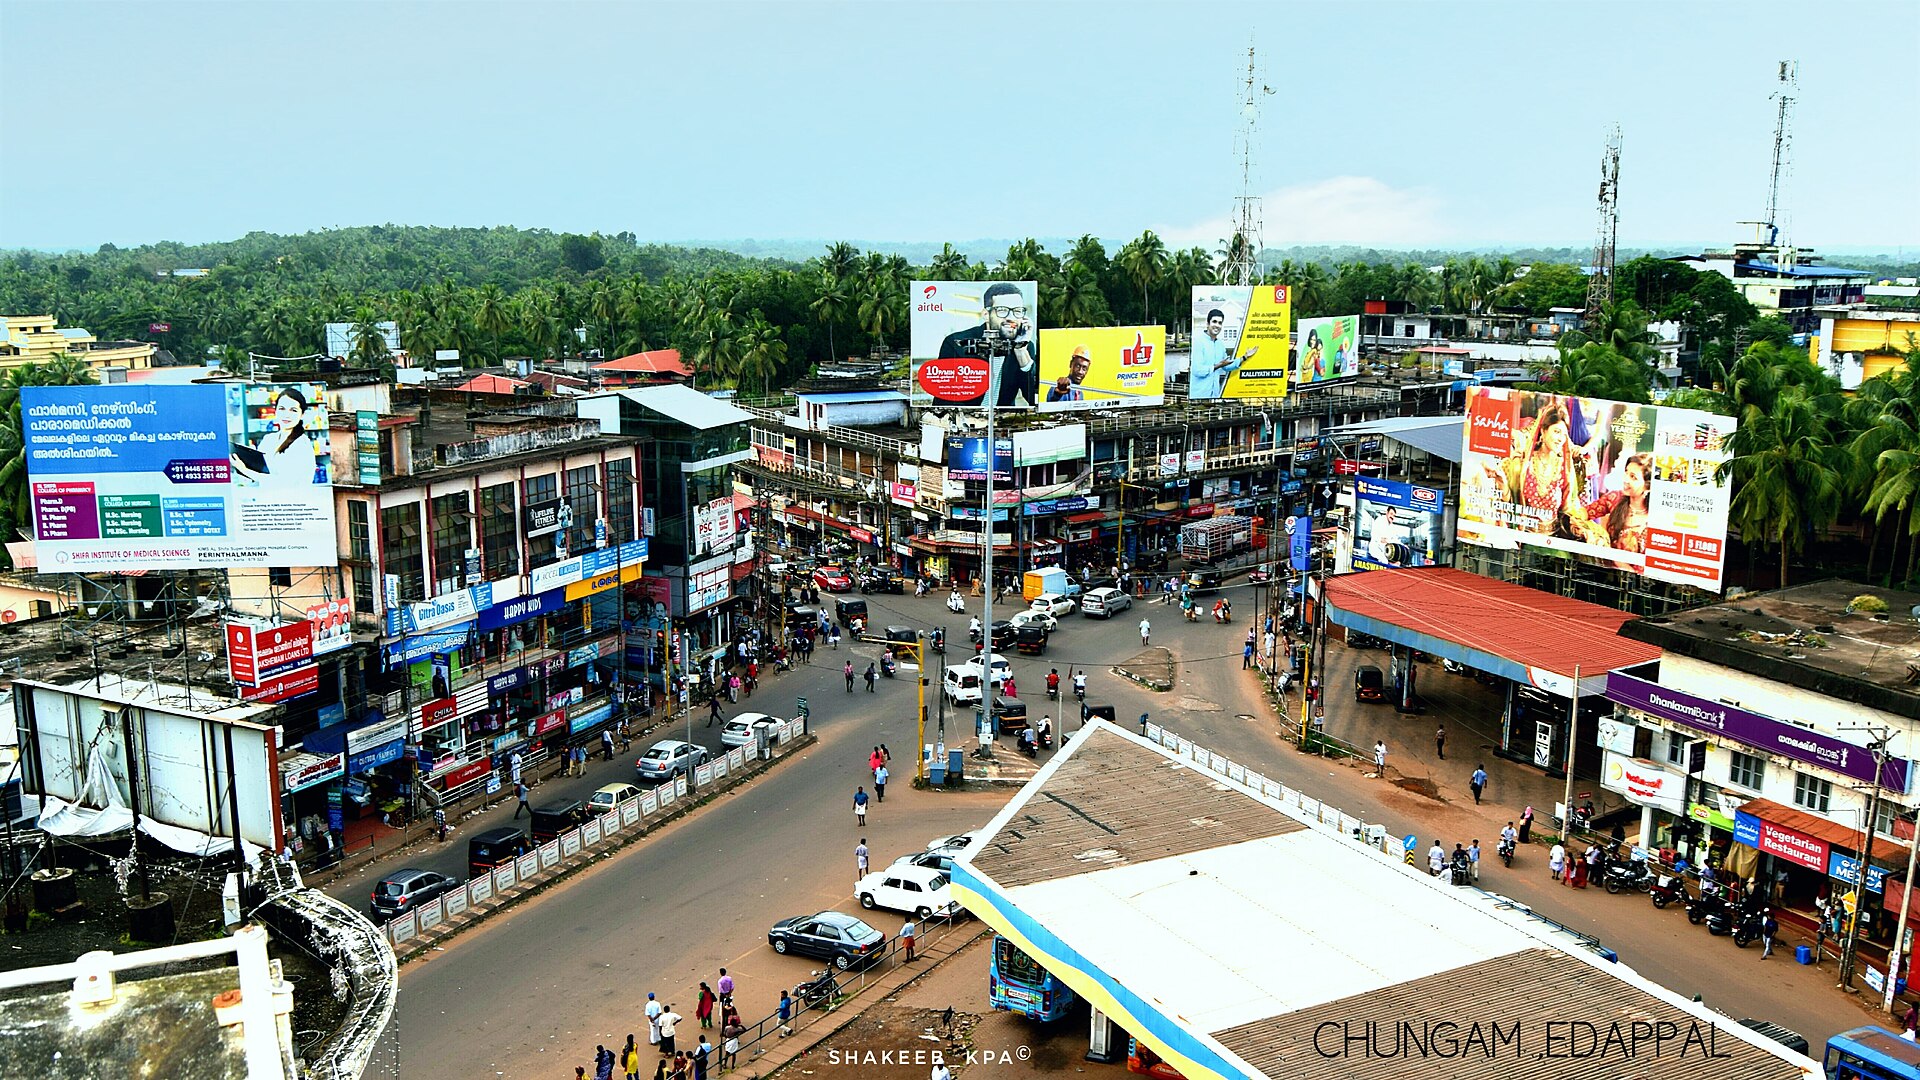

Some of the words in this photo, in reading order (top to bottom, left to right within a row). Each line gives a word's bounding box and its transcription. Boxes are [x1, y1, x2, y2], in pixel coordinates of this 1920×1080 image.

[917, 303, 943, 312] airtel
[1662, 491, 1681, 500] READY
[1683, 495, 1714, 506] STITCHING
[1674, 501, 1705, 513] DESIGNING
[699, 522, 713, 534] PSC
[436, 601, 455, 615] Oasis
[504, 601, 526, 620] HAPPY
[527, 597, 542, 613] KIDS
[1649, 693, 1718, 723] DhanlaxmiBank
[1765, 825, 1822, 854] Vegetarian
[1764, 837, 1822, 866] Restaurant
